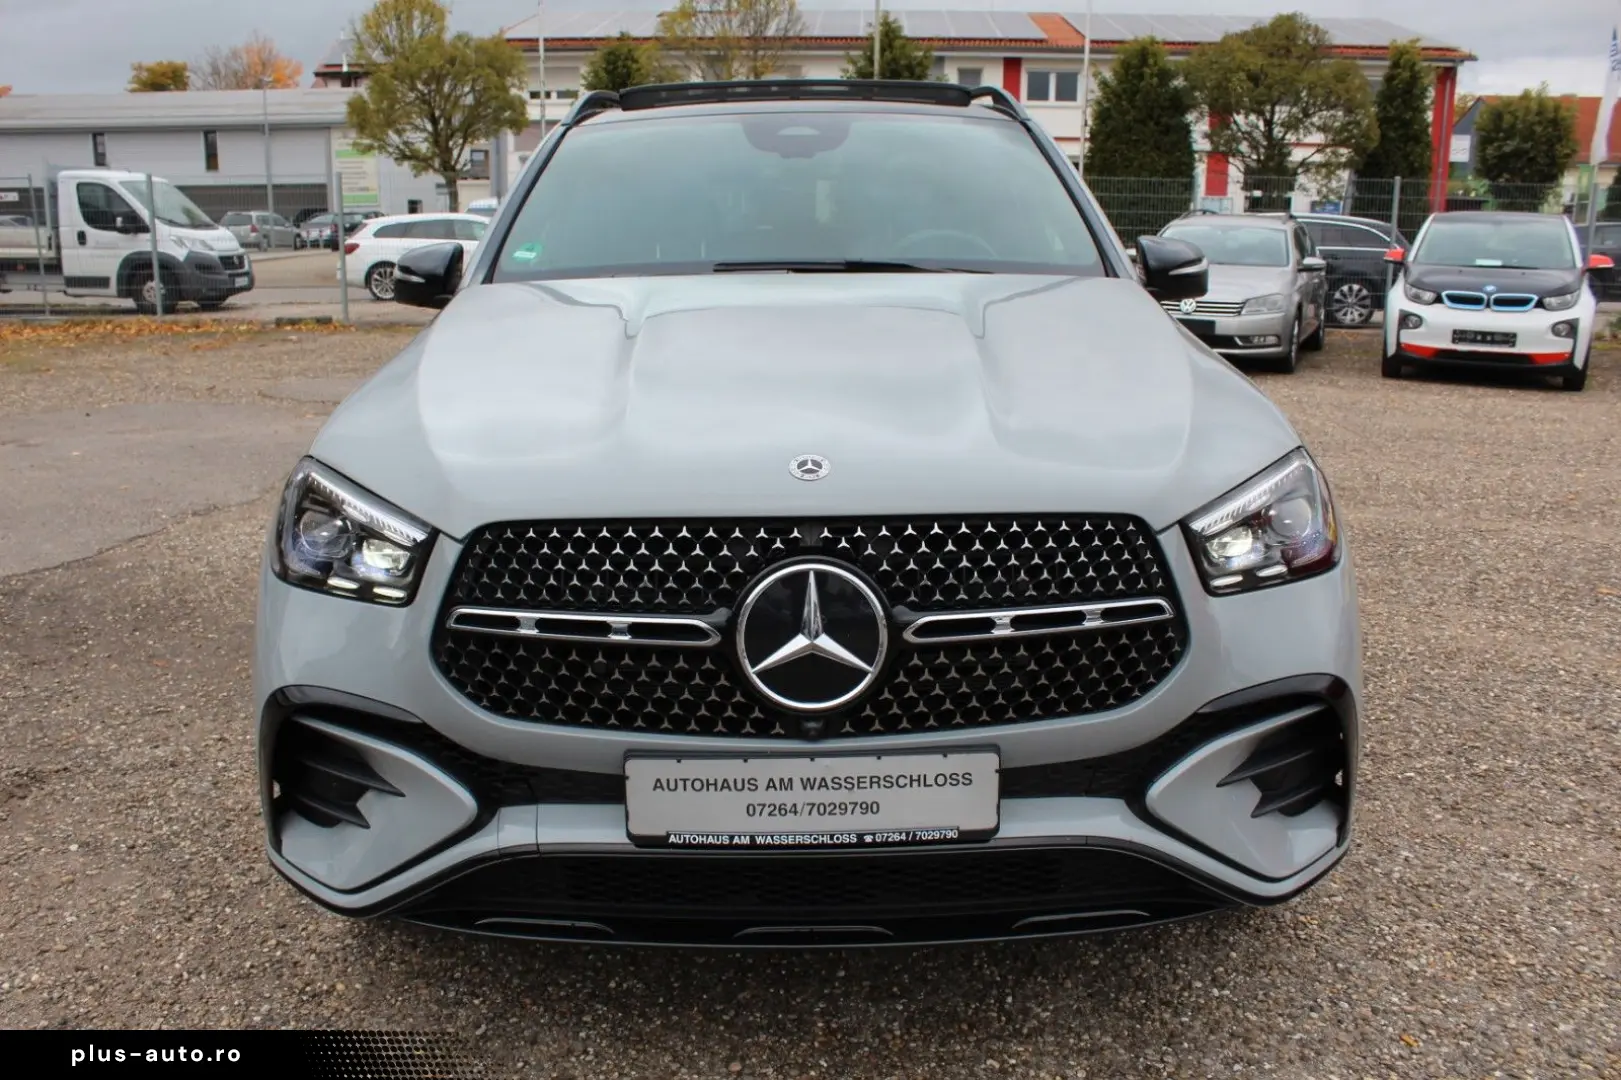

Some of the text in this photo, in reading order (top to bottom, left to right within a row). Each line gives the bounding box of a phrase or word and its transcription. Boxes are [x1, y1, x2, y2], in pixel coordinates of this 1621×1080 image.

[652, 772, 973, 792] AUTOHAUS AM WASSERSCHLOSS
[746, 801, 880, 818] 07264/7029790
[668, 834, 730, 845] AUTOHAUS
[732, 834, 751, 845] AM
[755, 833, 857, 845] WASSERSCHLOSS
[875, 831, 907, 842] 07264
[915, 829, 959, 840] 7029790
